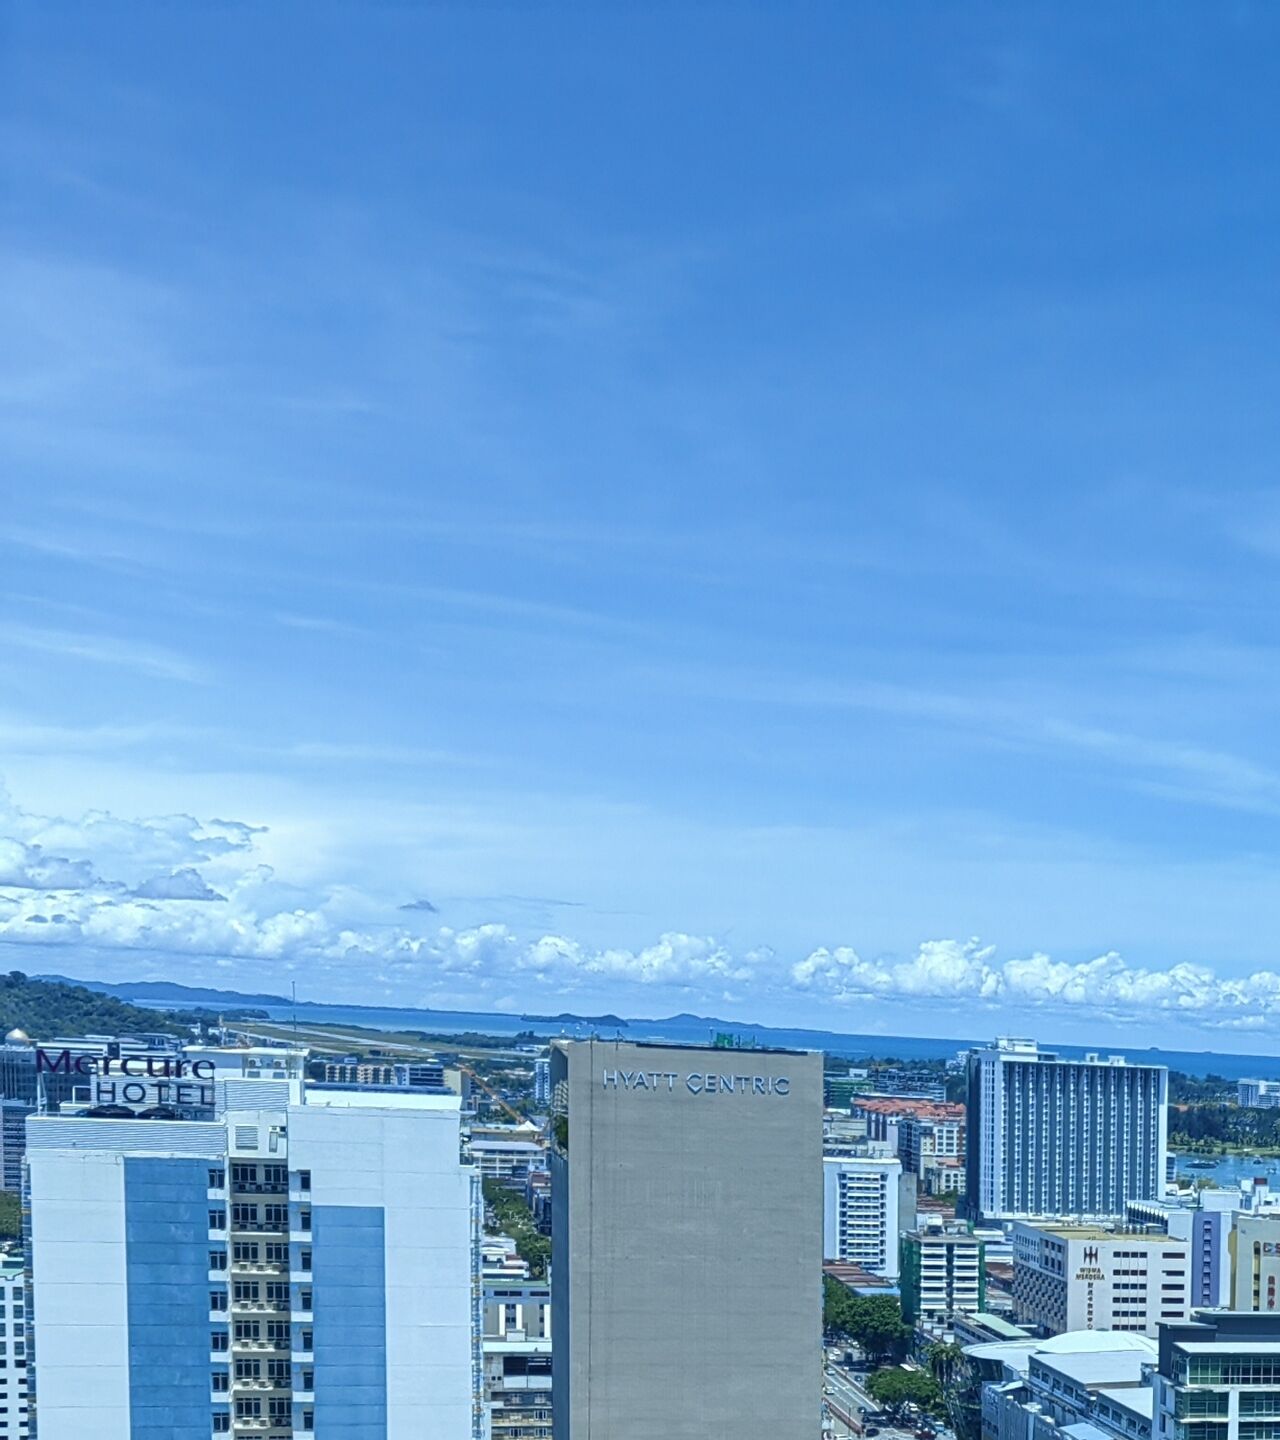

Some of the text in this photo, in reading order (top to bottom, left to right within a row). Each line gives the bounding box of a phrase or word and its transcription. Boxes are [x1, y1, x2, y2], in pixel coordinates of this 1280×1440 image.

[36, 1050, 216, 1079] Mercure
[96, 1081, 216, 1105] HOTEL
[603, 1069, 790, 1095] HYATT CENTRIC
